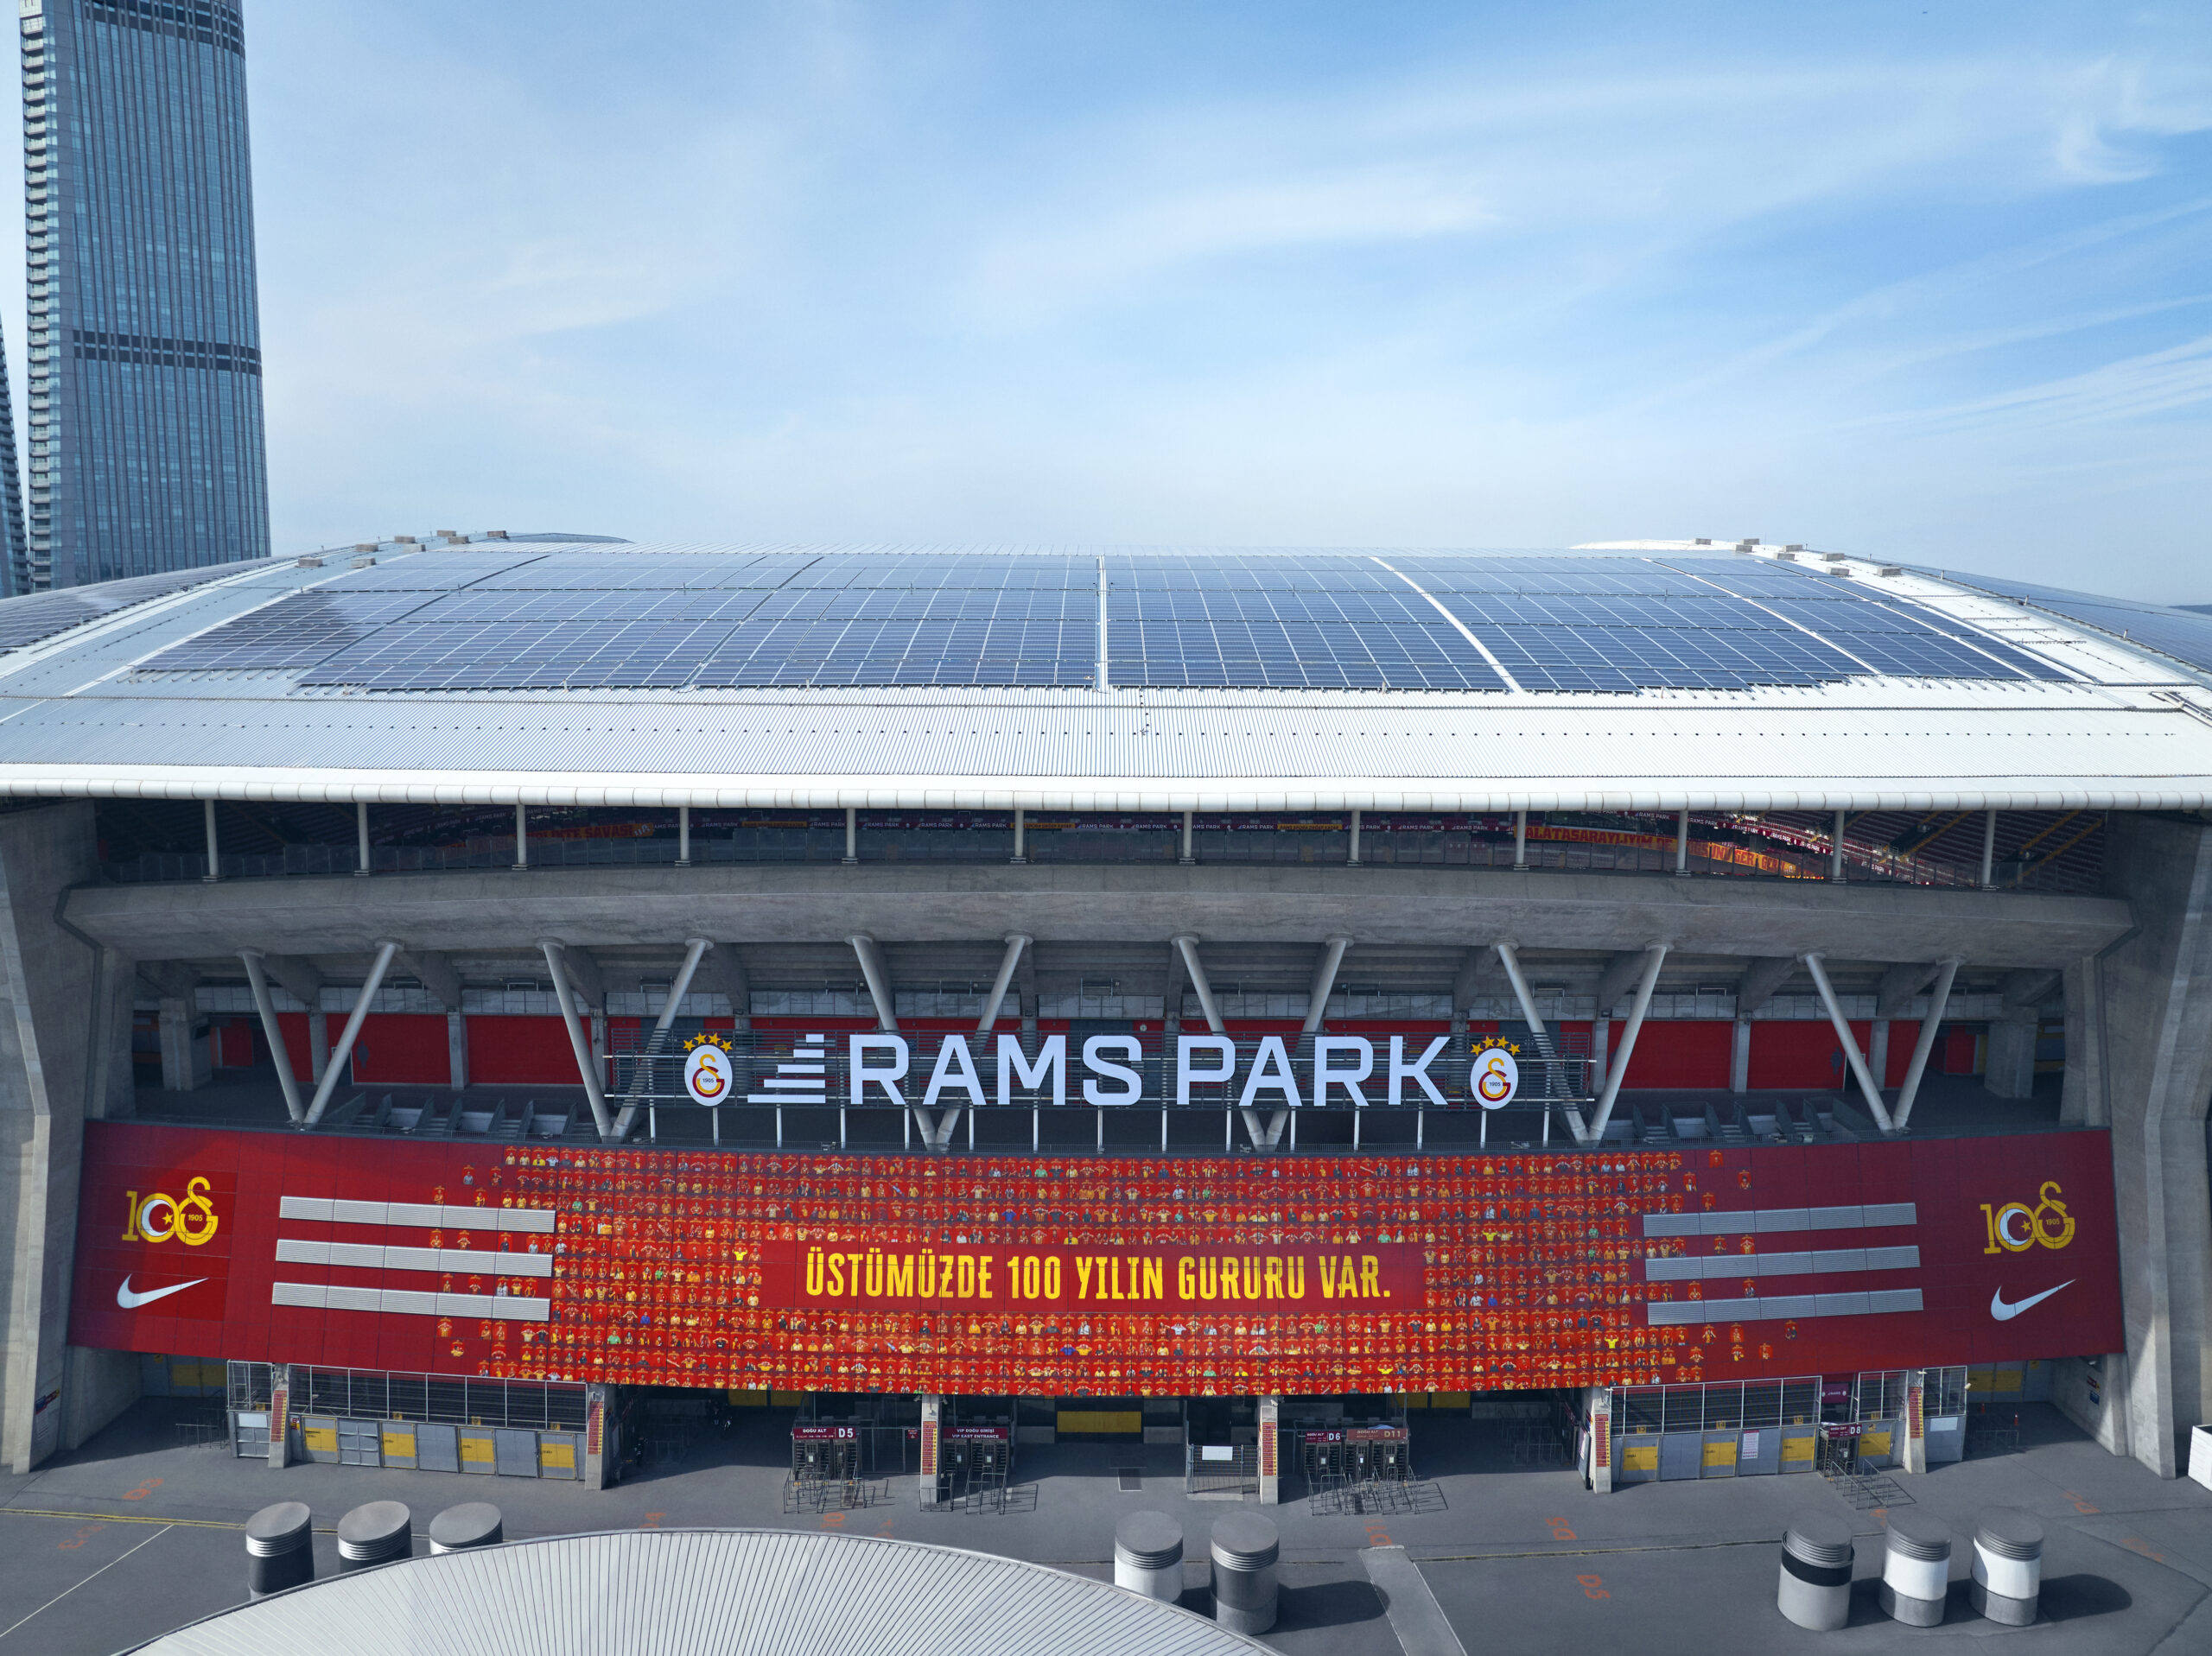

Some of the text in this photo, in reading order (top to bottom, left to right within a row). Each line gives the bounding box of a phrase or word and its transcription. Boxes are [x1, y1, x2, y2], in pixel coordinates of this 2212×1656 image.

[1525, 827, 1653, 846] ALATASARAYLIYIM
[849, 1034, 1451, 1107] RAMS PARK
[806, 1247, 1391, 1300] ÜSTÜMÜZDE 100 YILIN GURURU VAR.
[1545, 1517, 1577, 1541] D5
[1576, 1574, 1611, 1601] D5
